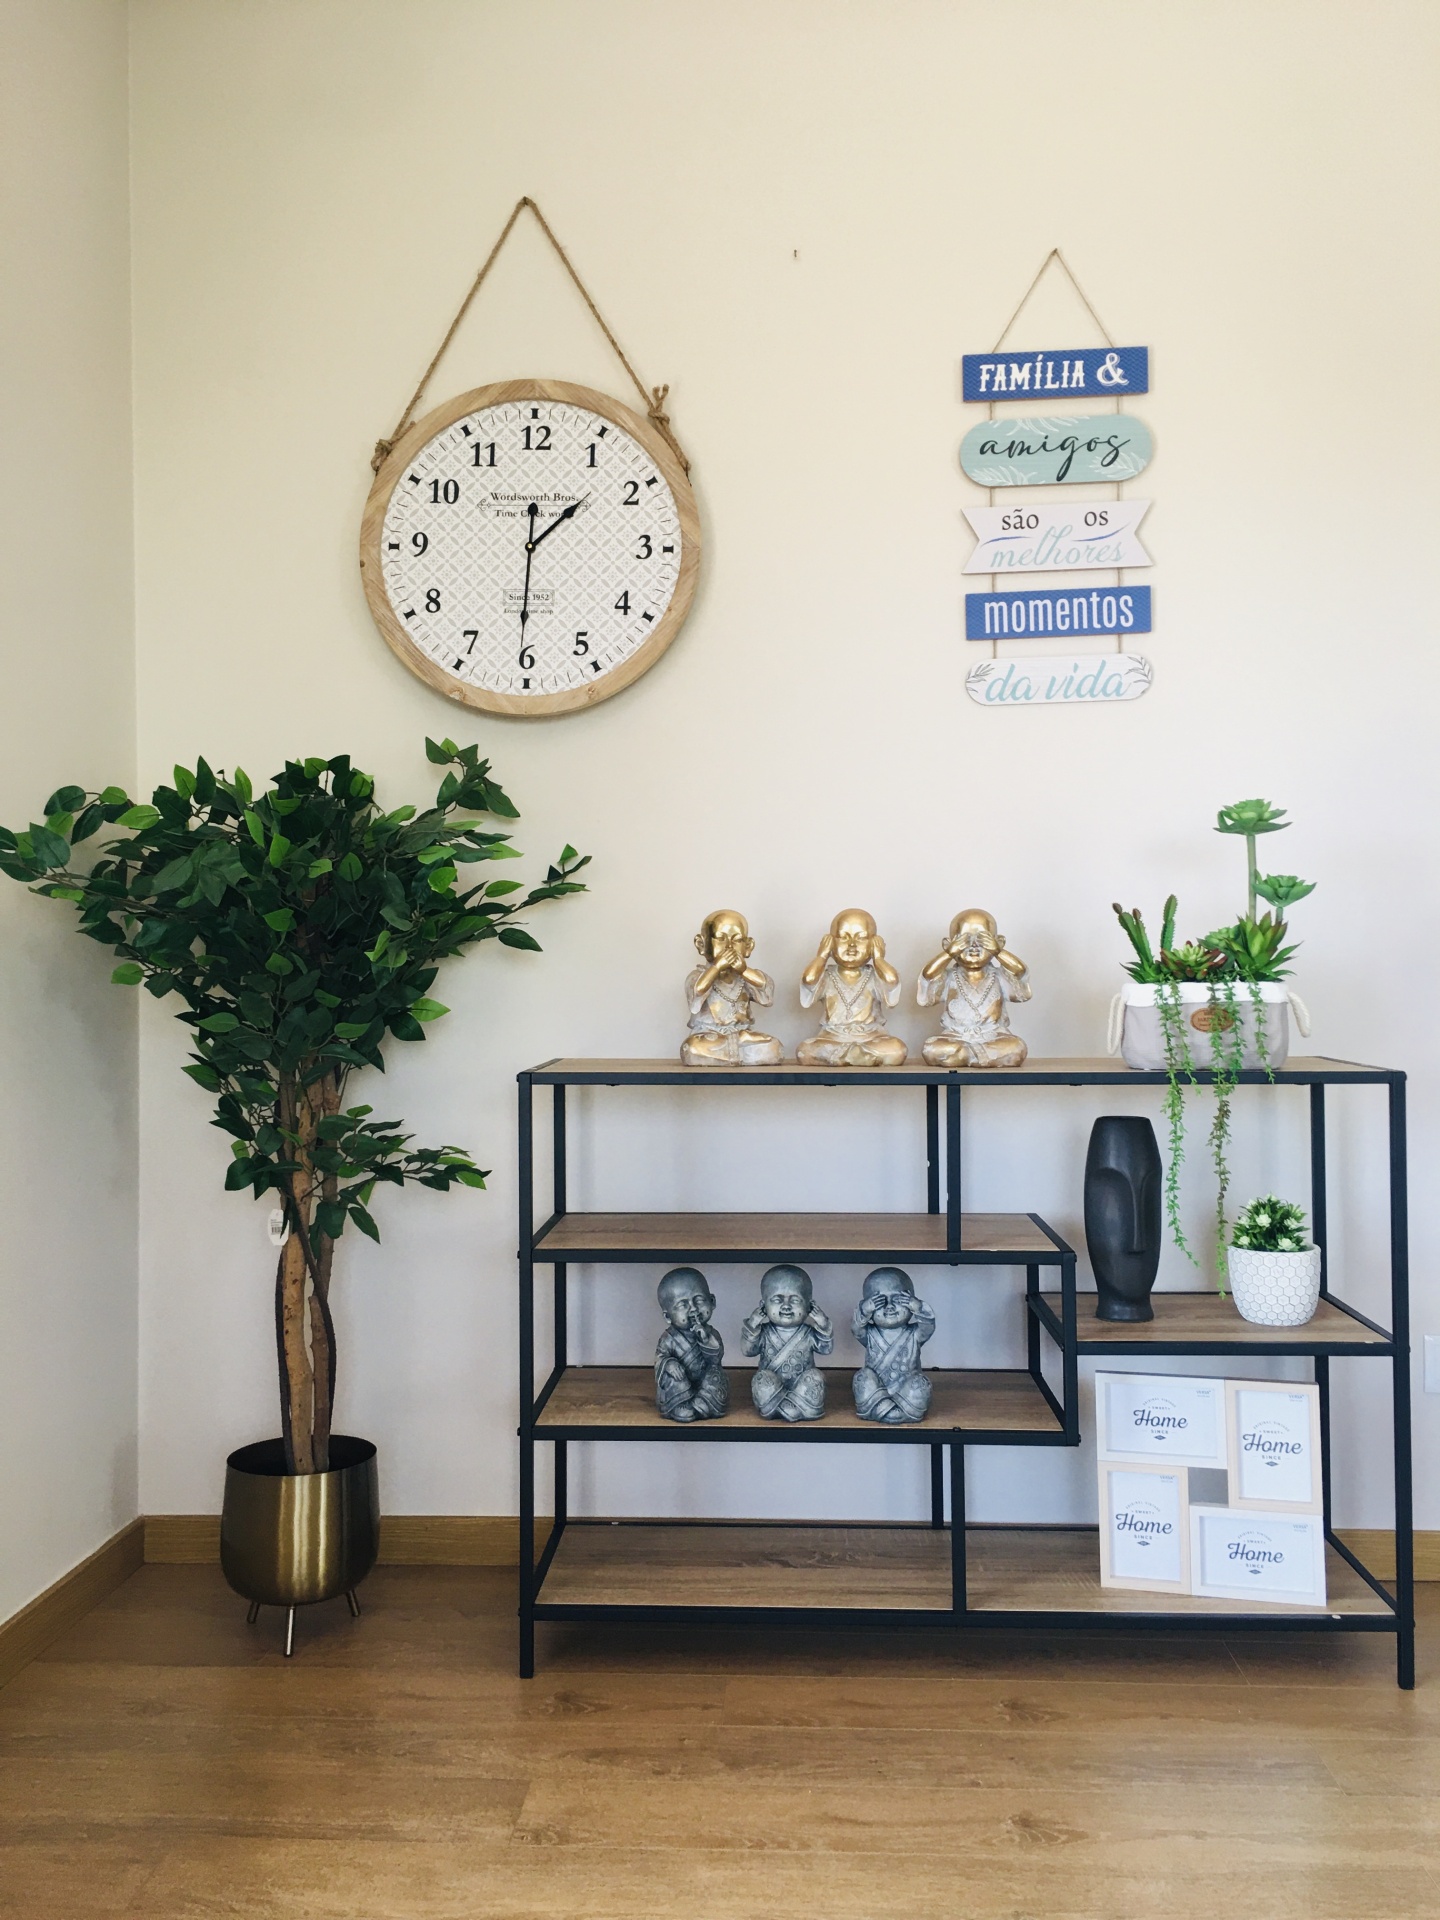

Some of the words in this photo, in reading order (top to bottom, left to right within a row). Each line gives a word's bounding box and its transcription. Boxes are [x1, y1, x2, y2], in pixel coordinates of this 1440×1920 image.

[979, 354, 1085, 392] FAMÍLIA
[1096, 352, 1129, 387] &
[521, 425, 552, 451] 12
[470, 442, 498, 468] 11
[585, 442, 598, 469] 1
[979, 433, 1131, 482] amigos
[428, 479, 460, 505] 10
[490, 492, 550, 502] Wordsworth
[553, 492, 579, 502] Bros.
[623, 480, 640, 506] 2
[495, 509, 518, 517] Time
[1002, 508, 1039, 530] são
[1084, 510, 1109, 527] os
[411, 531, 429, 557] 9
[635, 534, 653, 560] 3
[990, 524, 1126, 568] melhores
[425, 588, 442, 613] 8
[533, 593, 550, 601] 1952
[614, 590, 632, 616] 4
[984, 591, 1134, 634] momentos
[462, 630, 479, 655] 7
[572, 631, 589, 656] 5
[518, 644, 535, 670] 6
[985, 663, 1040, 702] da
[1045, 659, 1132, 700] vida
[1133, 1409, 1188, 1429] Home
[1242, 1433, 1303, 1454] Home
[1115, 1513, 1173, 1534] Home
[1227, 1543, 1284, 1563] Home
